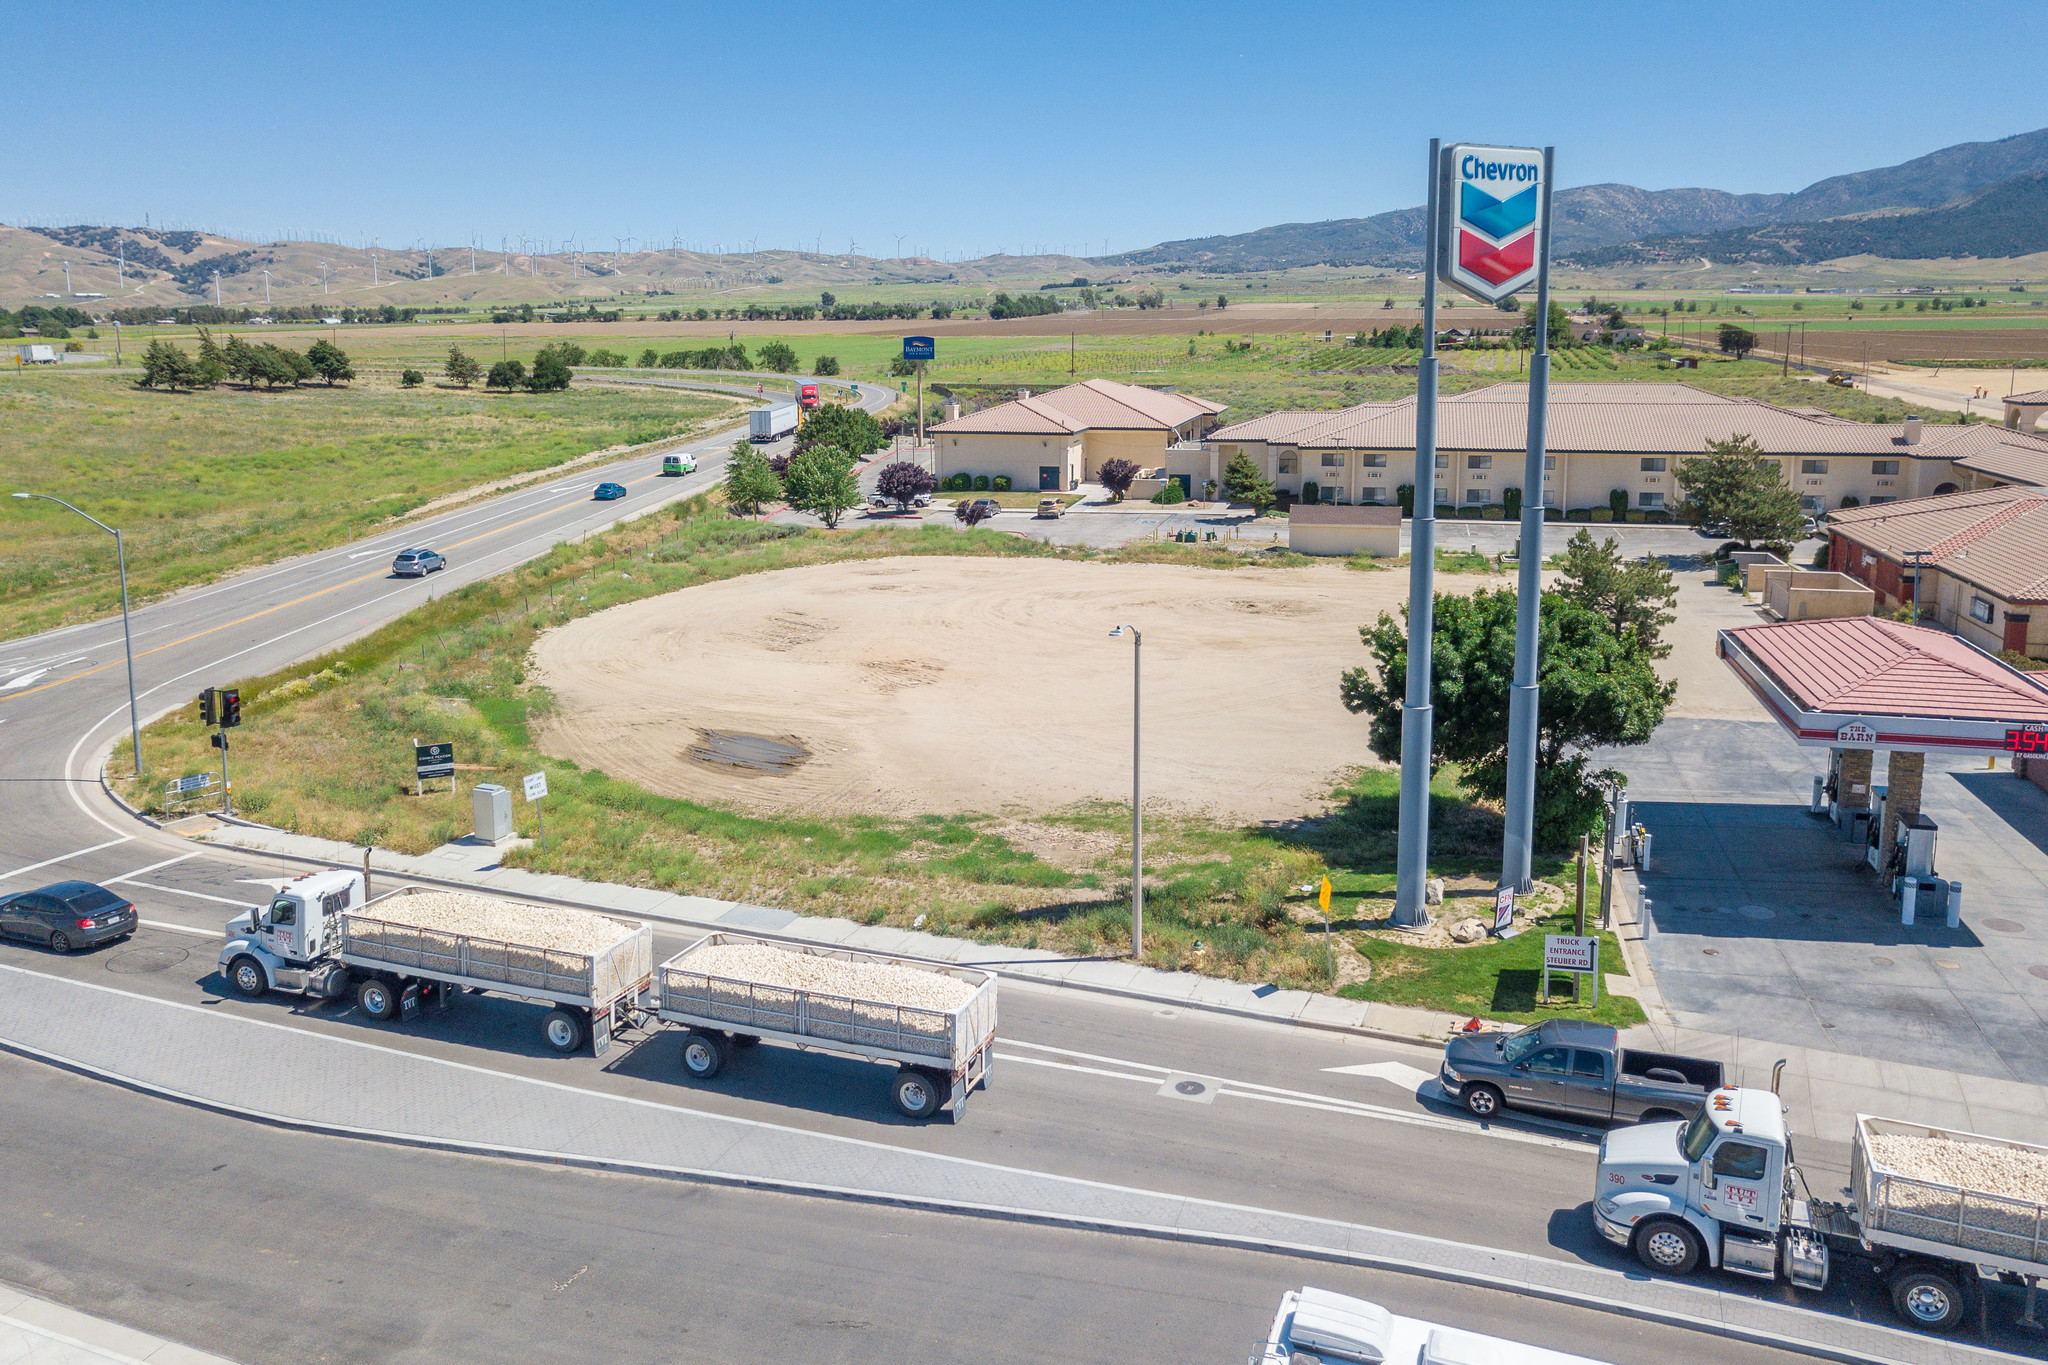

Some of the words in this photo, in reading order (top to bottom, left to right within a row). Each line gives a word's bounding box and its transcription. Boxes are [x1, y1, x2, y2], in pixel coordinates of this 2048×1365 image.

[1461, 154, 1538, 181] Chevron
[1849, 725, 1866, 733] THE
[1840, 732, 1873, 742] BARN
[1499, 893, 1512, 904] CFN
[277, 929, 293, 943] TVT
[1557, 937, 1580, 946] TRUCK
[1549, 947, 1586, 956] ENTRANCE
[1546, 956, 1577, 965] STEUBER
[403, 996, 415, 1010] TVT
[596, 1033, 608, 1049] TVT
[1608, 1172, 1625, 1185] 390
[1726, 1185, 1756, 1204] TVT
